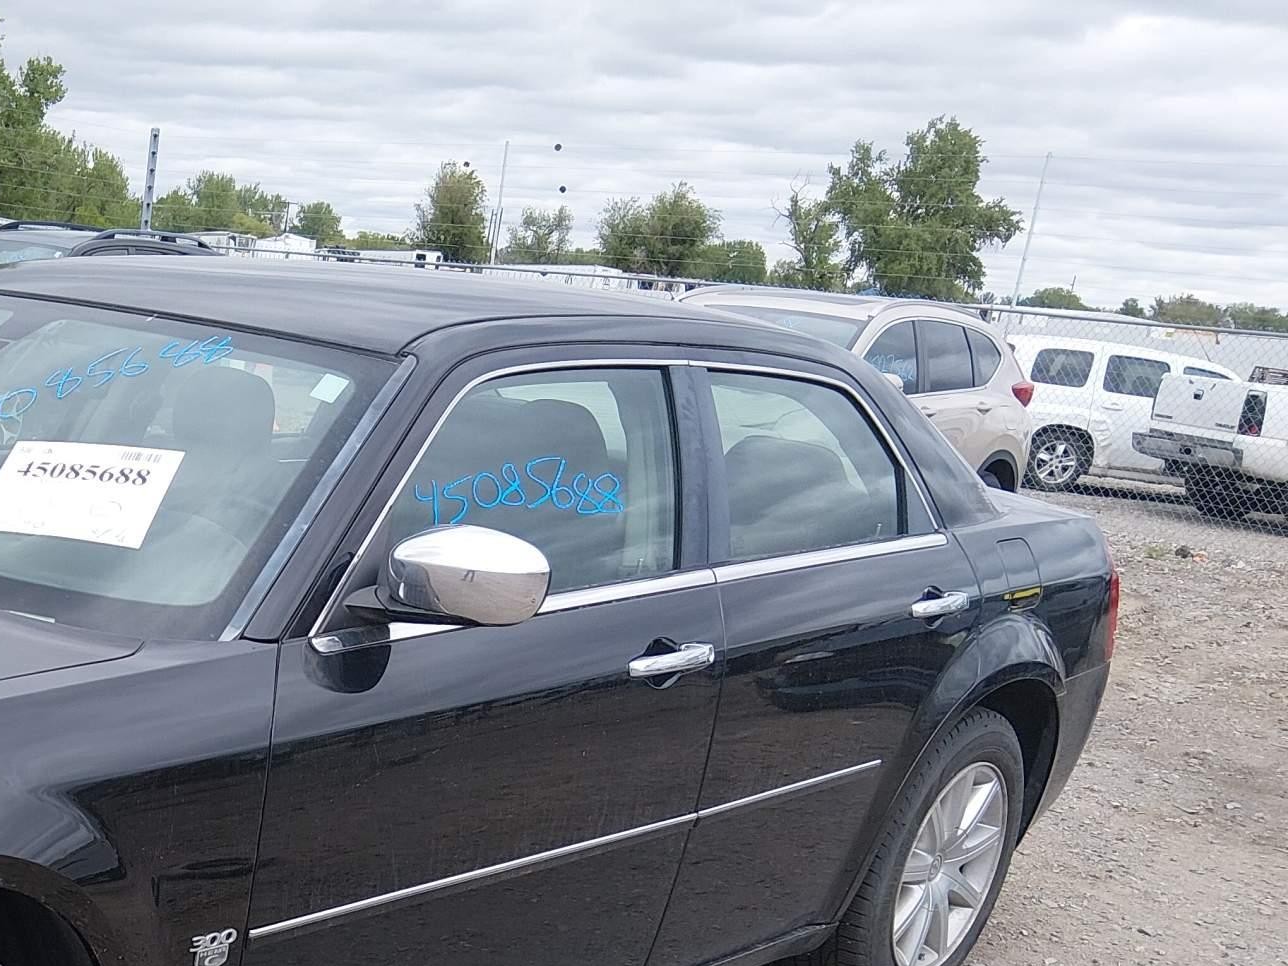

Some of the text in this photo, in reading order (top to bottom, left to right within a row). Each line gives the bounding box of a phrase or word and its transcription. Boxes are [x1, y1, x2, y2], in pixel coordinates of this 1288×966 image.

[17, 459, 152, 487] 45085688
[415, 456, 624, 527] 45085688
[189, 928, 238, 953] 300
